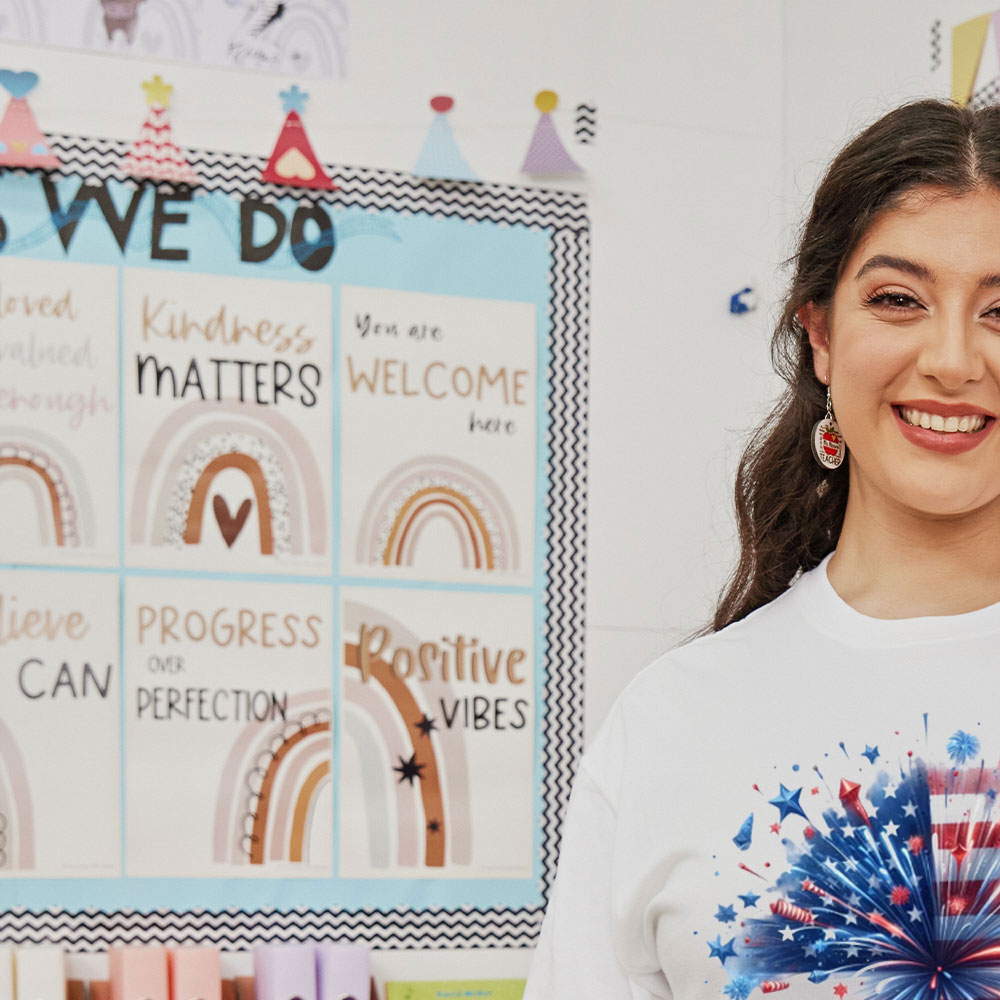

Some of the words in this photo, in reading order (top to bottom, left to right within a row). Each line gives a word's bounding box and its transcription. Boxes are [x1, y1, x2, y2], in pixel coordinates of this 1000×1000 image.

[41, 174, 194, 261] WE
[239, 198, 336, 273] DO
[142, 294, 316, 354] Kindness
[355, 311, 398, 338] You
[137, 353, 322, 408] MATTERS
[346, 354, 530, 406] WELCOME
[137, 605, 324, 649] PROGRESS
[148, 654, 186, 674] OVER
[359, 622, 527, 685] Positive
[18, 657, 113, 700] CAN
[137, 686, 289, 723] PERFECTION
[439, 695, 530, 731] VIBES
